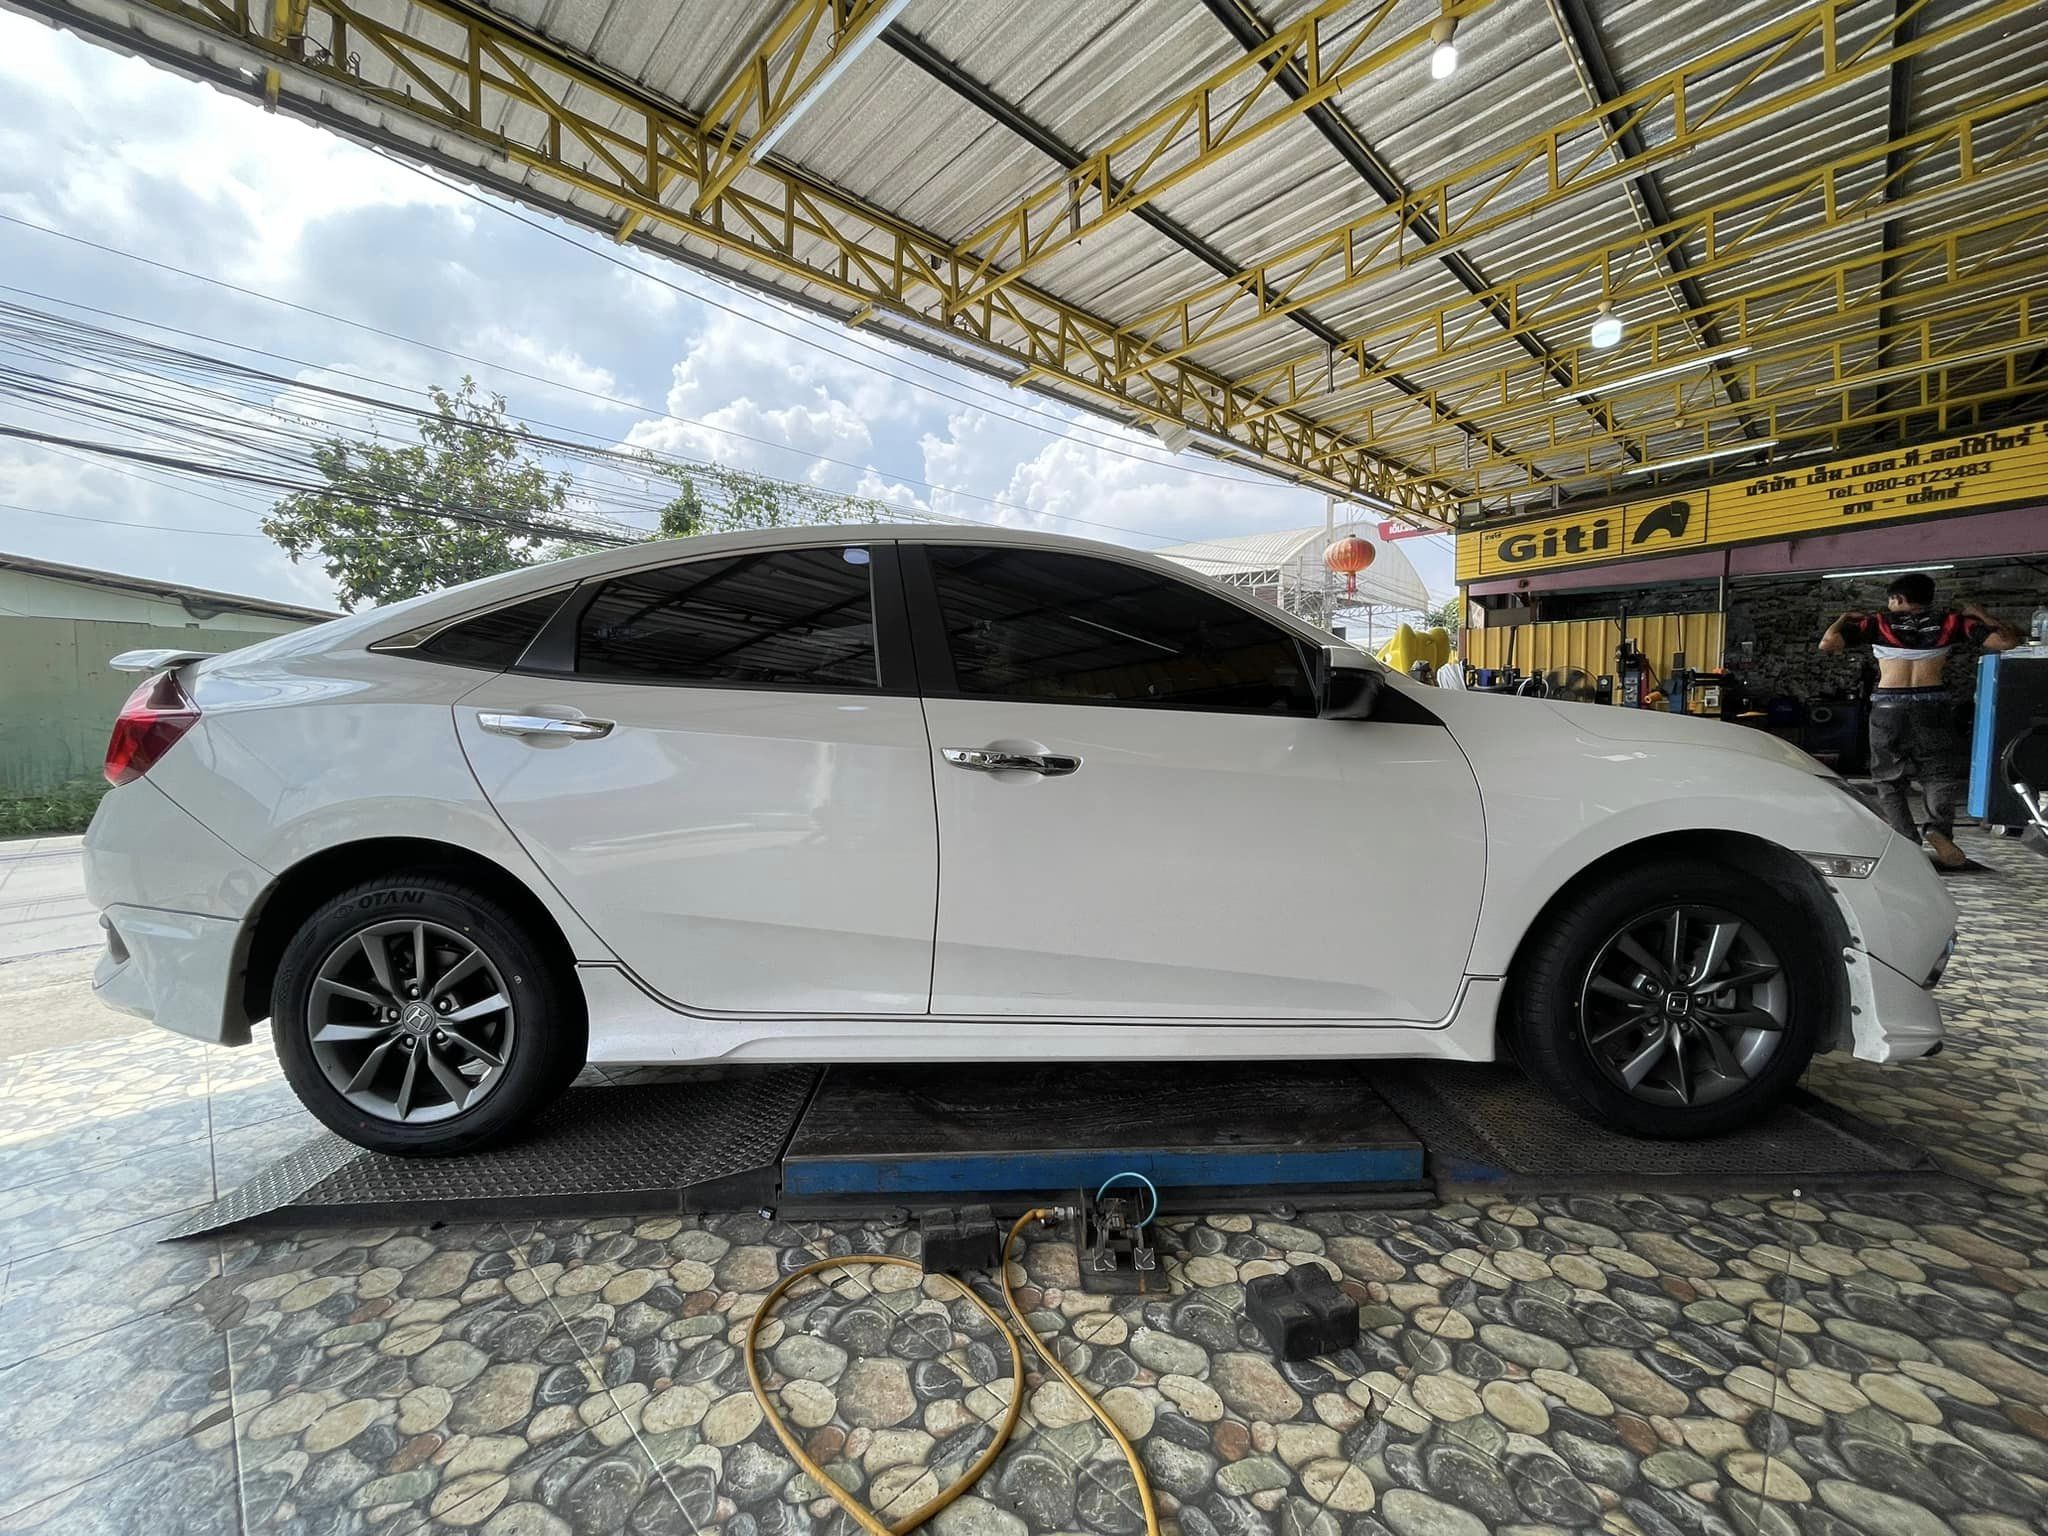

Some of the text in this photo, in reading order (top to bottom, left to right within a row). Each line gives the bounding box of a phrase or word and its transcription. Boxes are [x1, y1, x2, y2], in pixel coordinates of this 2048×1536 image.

[1746, 475, 1797, 496] บริษัท
[1826, 460, 1991, 499] Tel. 080-6123483
[1498, 519, 1609, 563] Giti
[359, 890, 425, 909] OTANI
